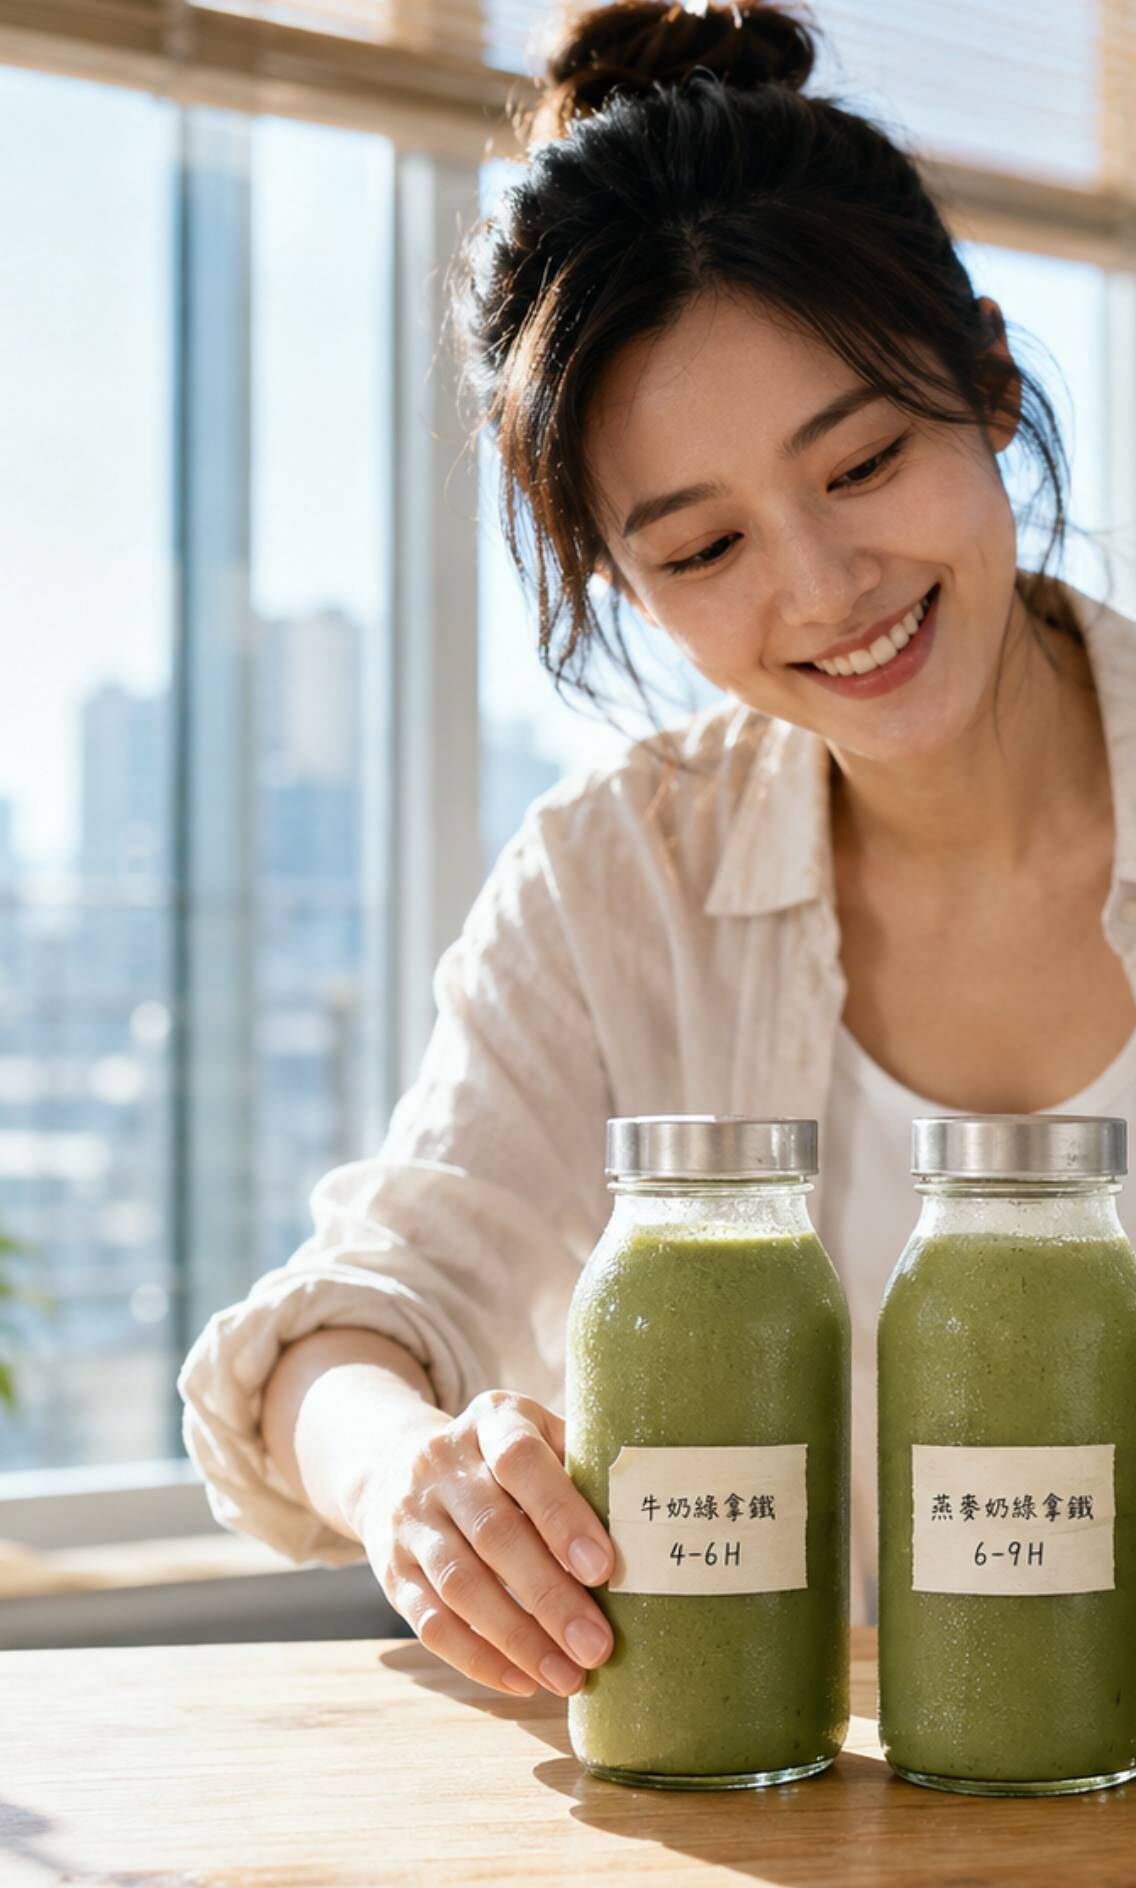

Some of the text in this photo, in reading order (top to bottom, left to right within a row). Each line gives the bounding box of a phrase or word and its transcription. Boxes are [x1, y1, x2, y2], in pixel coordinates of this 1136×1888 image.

[640, 1492, 777, 1522] 牛奶綠拿鐵
[930, 1492, 1095, 1522] 燕麥奶綠拿鐵
[669, 1541, 741, 1567] 4-6H
[973, 1541, 1044, 1567] 6-9H
